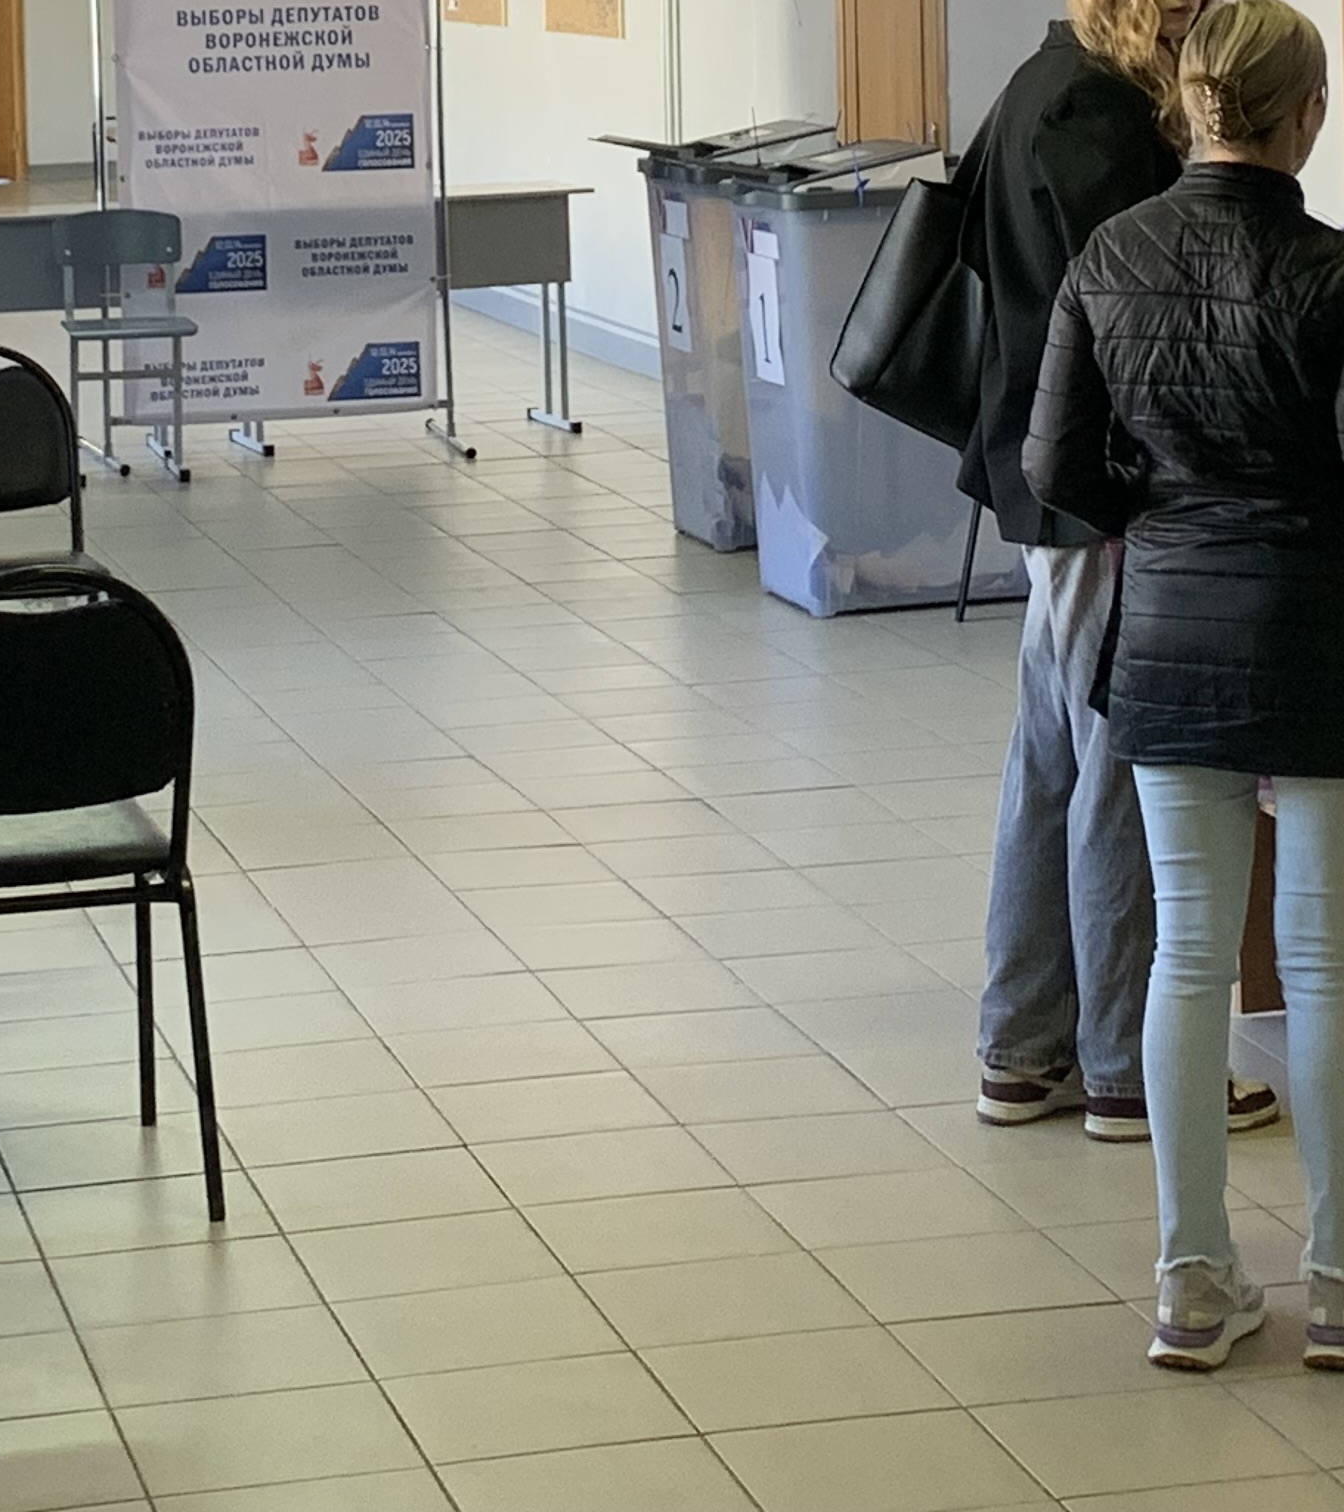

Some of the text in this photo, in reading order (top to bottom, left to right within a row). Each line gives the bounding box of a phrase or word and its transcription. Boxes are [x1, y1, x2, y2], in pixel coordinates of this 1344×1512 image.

[176, 5, 380, 27] ВЫБОРЫ ДЕПУТАТОВ
[205, 25, 353, 50] ВОРОНЕЖСКОЙ
[189, 50, 370, 73] ОБЛАСТНОЙ ДУМЫ
[138, 127, 260, 141] ВЫБОРЫ ДЕПУТАТОВ
[376, 129, 411, 147] 2025
[156, 140, 244, 155] ВОРОНЕЖСКОЙ
[145, 154, 255, 169] ОБЛАСТНОЙ ДУМЫ
[294, 235, 414, 249] ВЫБОРЫ ДЕПУТАТОВ
[227, 250, 263, 268] 2025
[311, 248, 399, 263] ВОРОНЕЖСКОЙ
[301, 263, 409, 277] ОБЛАСТНОЙ ДУМЫ
[668, 268, 683, 334] 2
[758, 293, 772, 364] 1
[200, 358, 265, 372] ДЕПУТАТОВ
[382, 357, 418, 375] 2025
[223, 386, 260, 399] ДУМЫ
